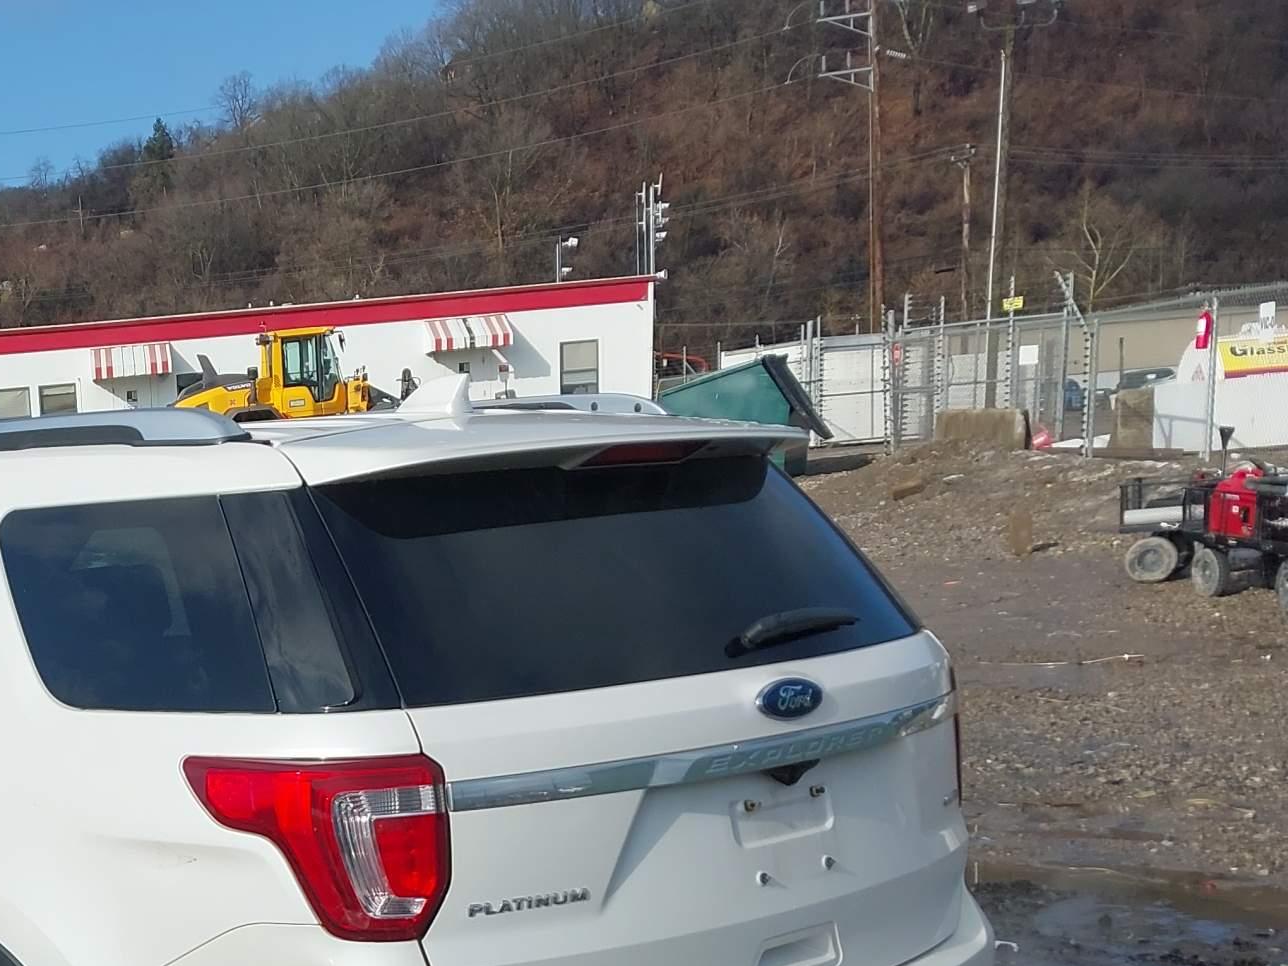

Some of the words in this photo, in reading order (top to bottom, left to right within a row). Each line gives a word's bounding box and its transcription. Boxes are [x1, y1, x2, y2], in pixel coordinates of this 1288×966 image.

[1230, 344, 1288, 357] Glass
[777, 684, 814, 711] Ford
[705, 728, 886, 774] EXPLORER
[467, 886, 592, 918] PLATINUM
